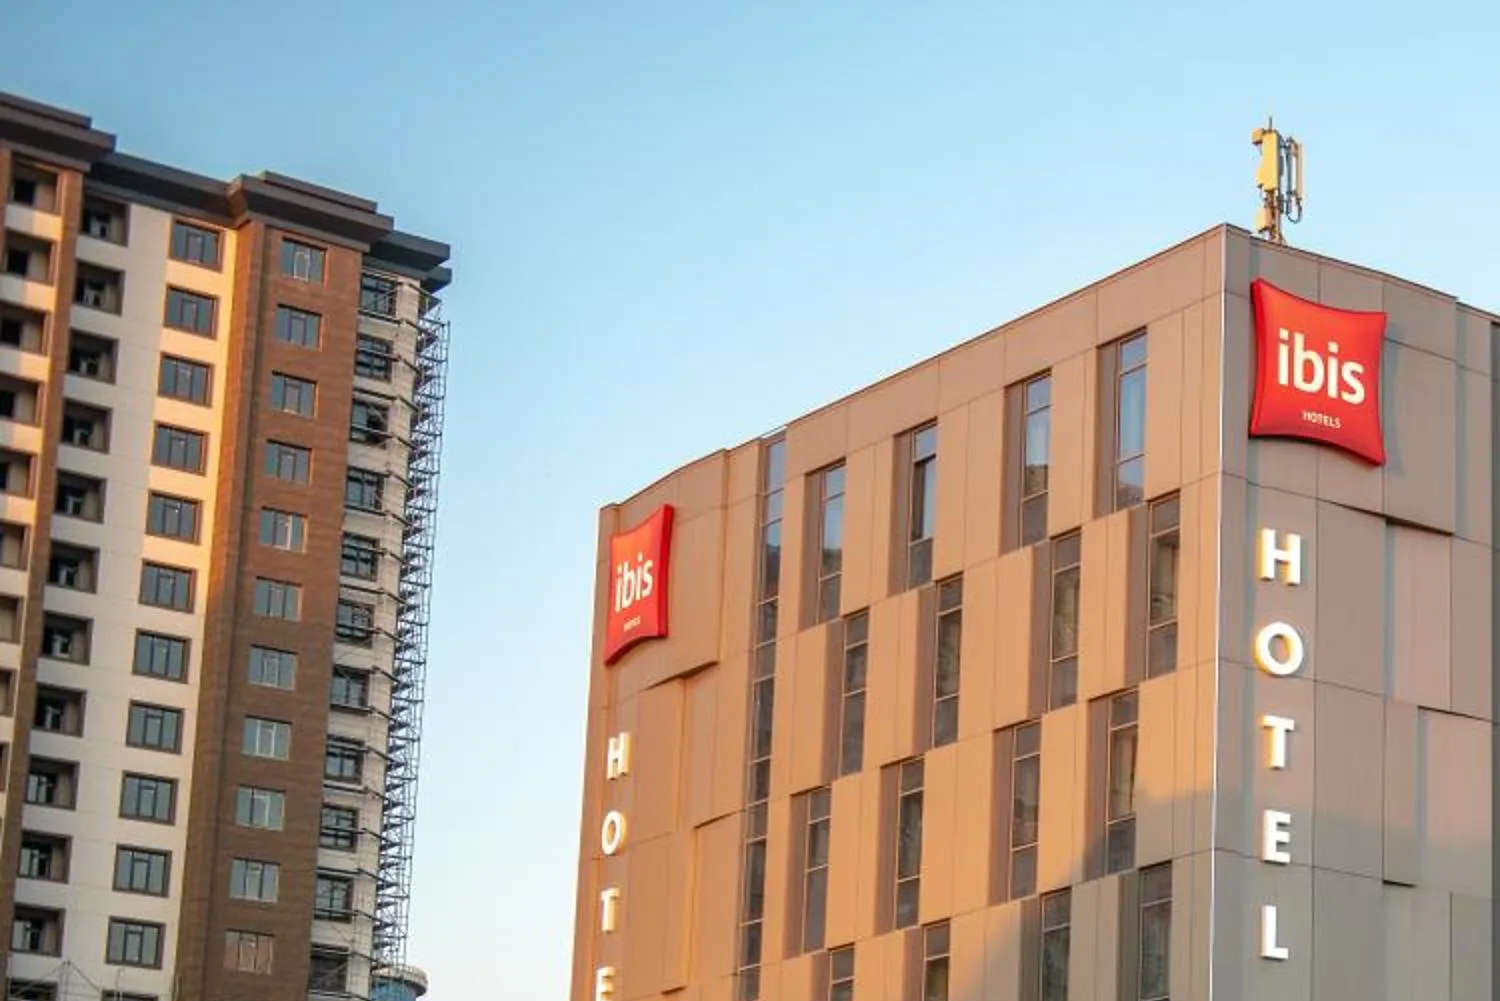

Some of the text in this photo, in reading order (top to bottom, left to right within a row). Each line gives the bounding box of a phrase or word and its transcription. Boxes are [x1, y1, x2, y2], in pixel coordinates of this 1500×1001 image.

[1278, 328, 1366, 405] ibis
[1302, 411, 1341, 430] HOTELS
[614, 551, 653, 613] ibis
[1253, 528, 1304, 961] HOTEL
